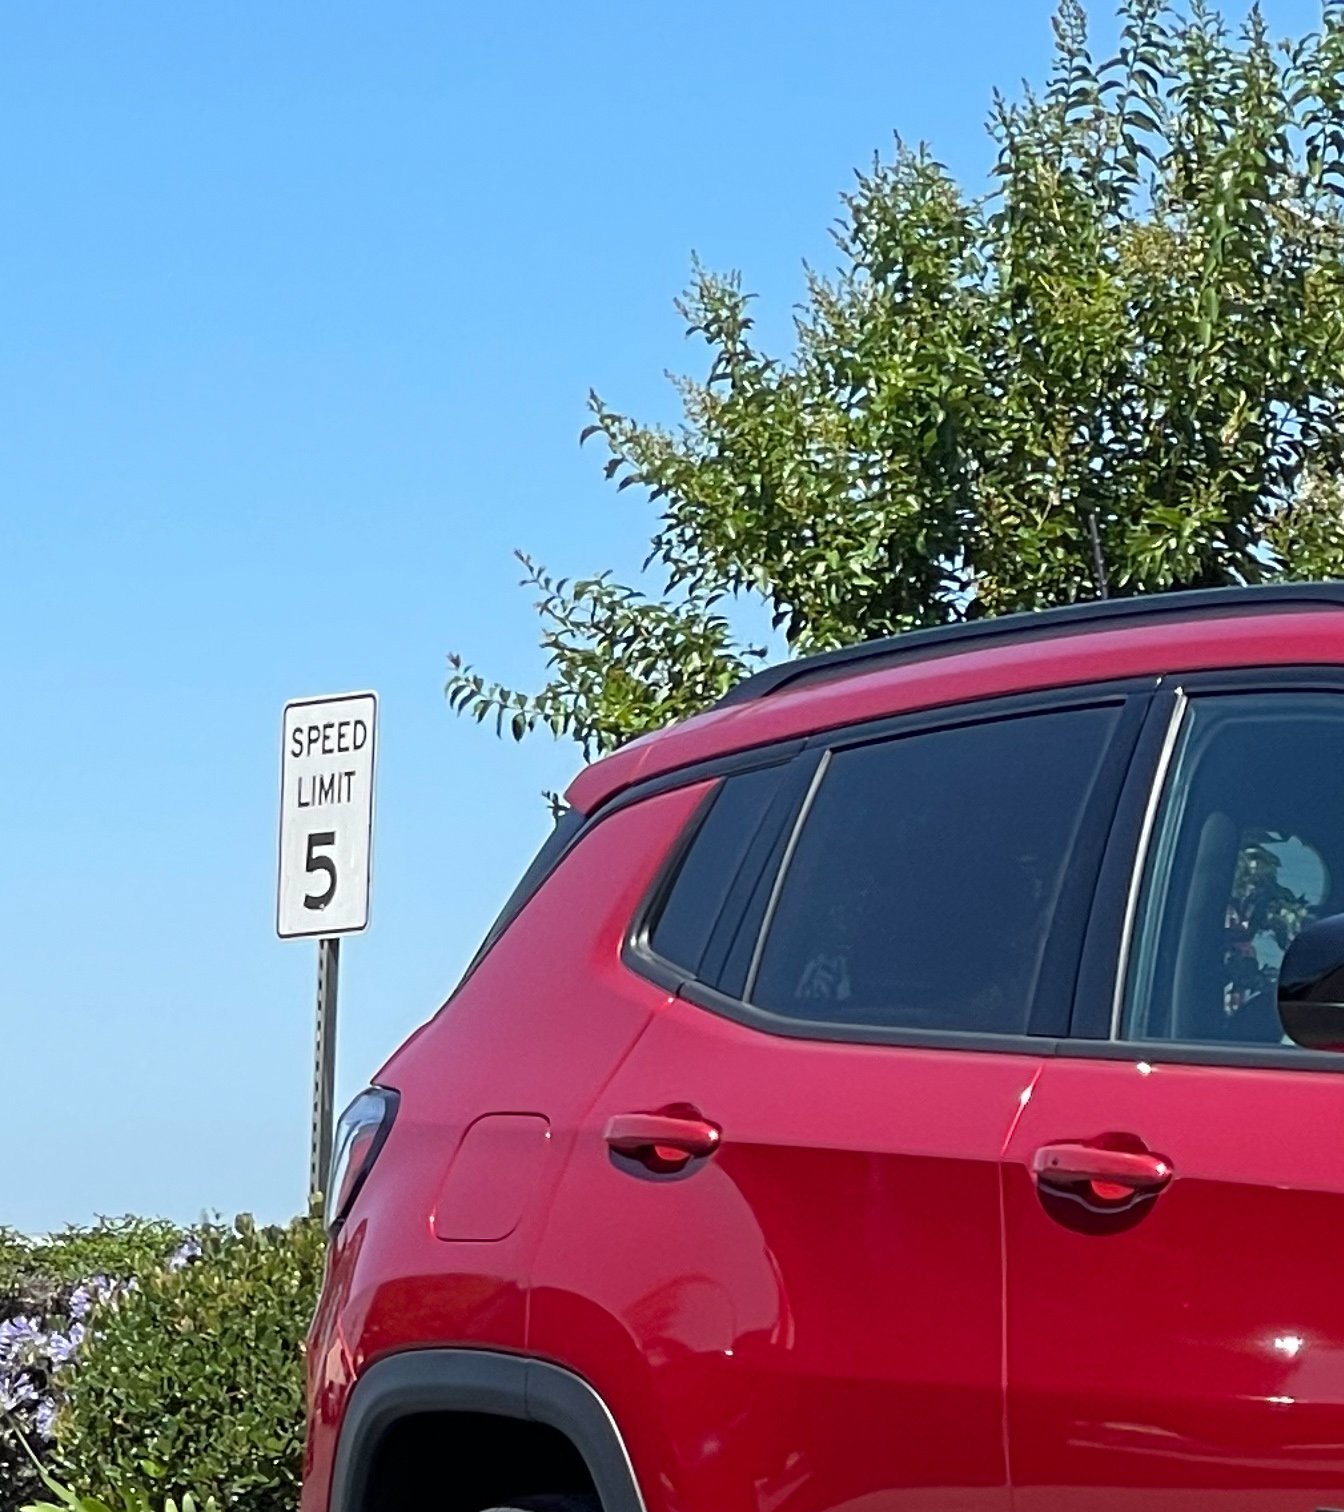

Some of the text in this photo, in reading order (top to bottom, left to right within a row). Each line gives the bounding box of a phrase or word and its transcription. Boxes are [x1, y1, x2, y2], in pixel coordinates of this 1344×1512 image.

[291, 719, 367, 758] SPEED
[297, 771, 356, 808] LIMIT
[303, 831, 337, 911] 5
